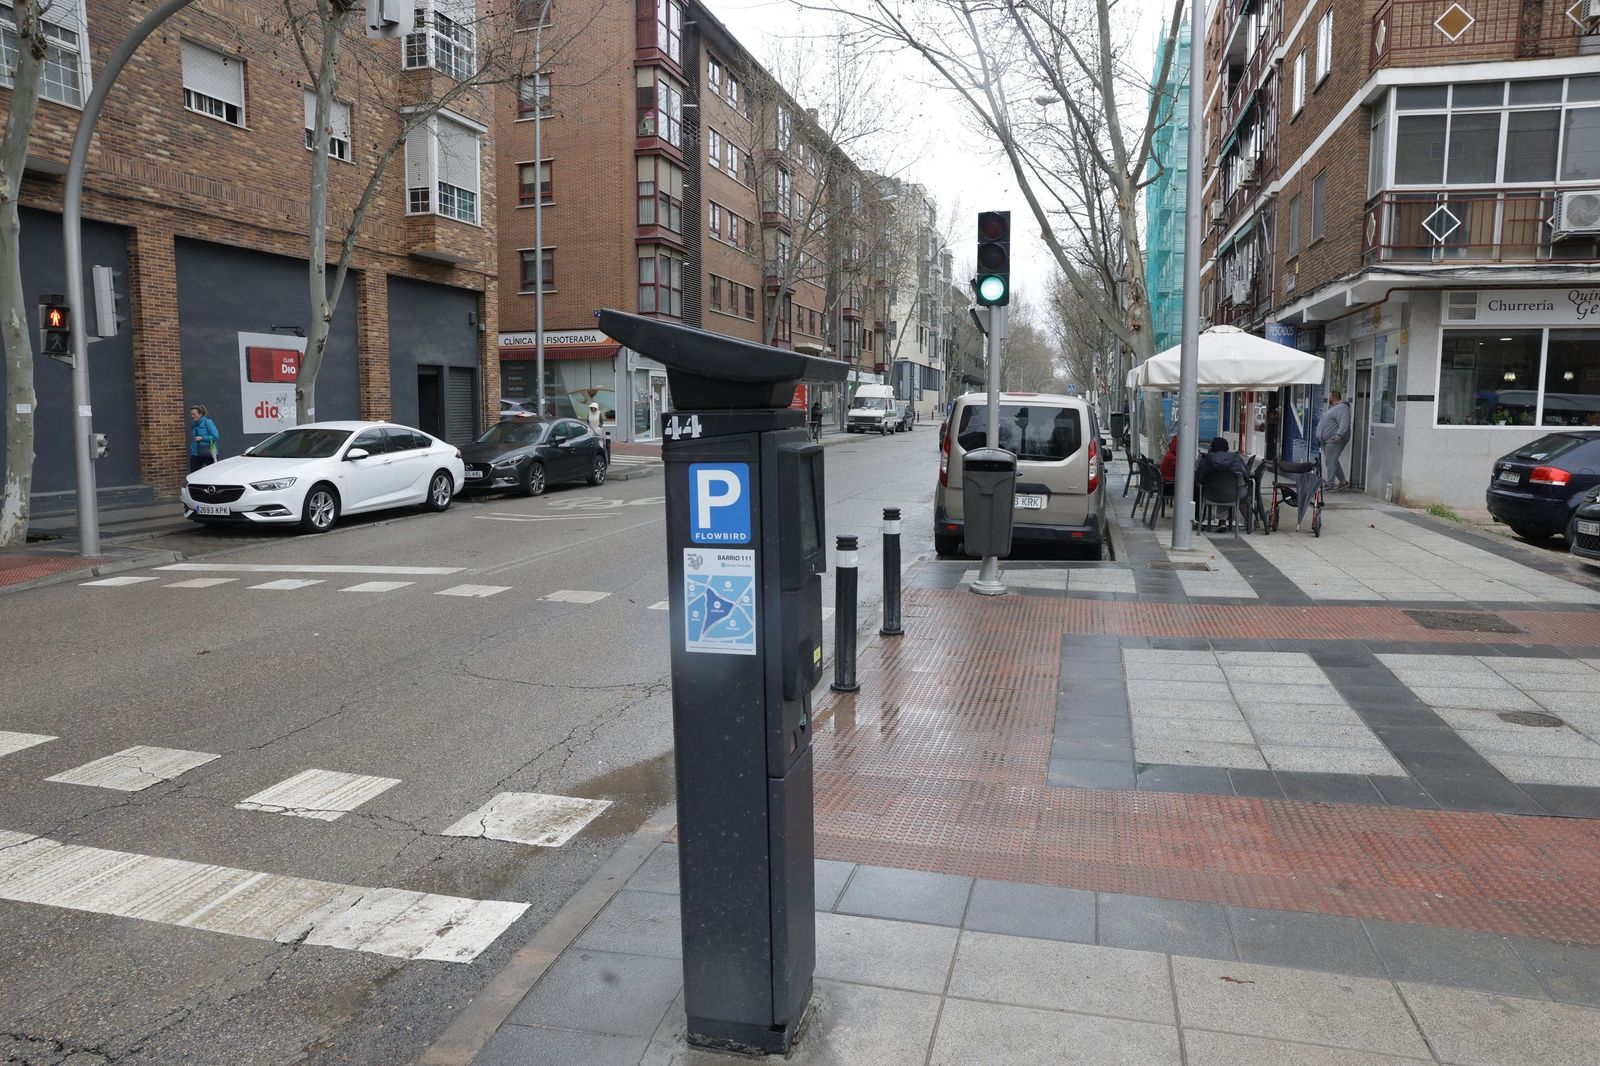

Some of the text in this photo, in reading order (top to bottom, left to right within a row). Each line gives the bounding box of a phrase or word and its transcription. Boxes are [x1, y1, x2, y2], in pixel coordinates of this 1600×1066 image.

[1488, 299, 1554, 311] Churrería
[1269, 326, 1294, 336] PESCADOS
[504, 335, 533, 346] CLÍNICA
[546, 335, 597, 344] FISIOTERAPIA
[665, 414, 703, 440] 44
[696, 469, 741, 529] P
[1022, 497, 1039, 507] KRK
[215, 506, 228, 514] KPK
[695, 532, 747, 540] FLOWBIRD
